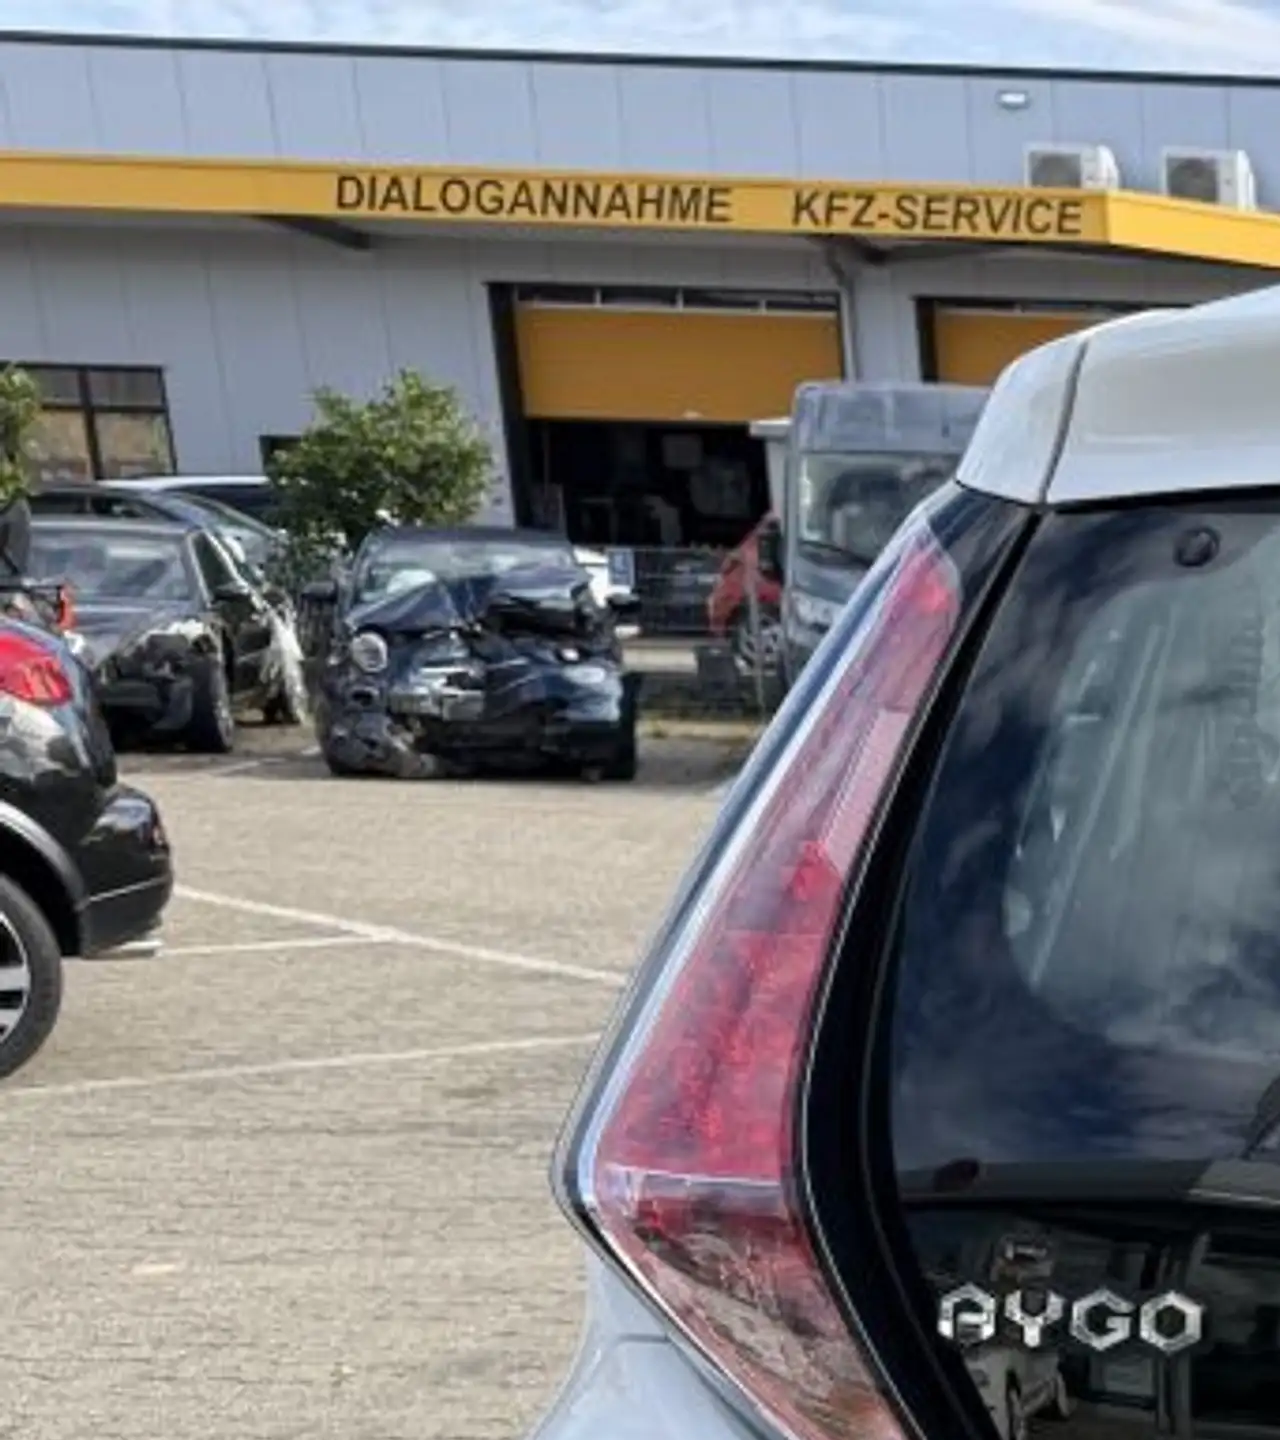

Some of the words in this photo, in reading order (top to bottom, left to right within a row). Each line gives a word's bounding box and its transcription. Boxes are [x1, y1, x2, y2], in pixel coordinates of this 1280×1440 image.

[336, 174, 733, 223] DIALOGANNAHME
[791, 188, 1083, 235] KFZ-SERVICE
[936, 1282, 1205, 1355] AYGO
